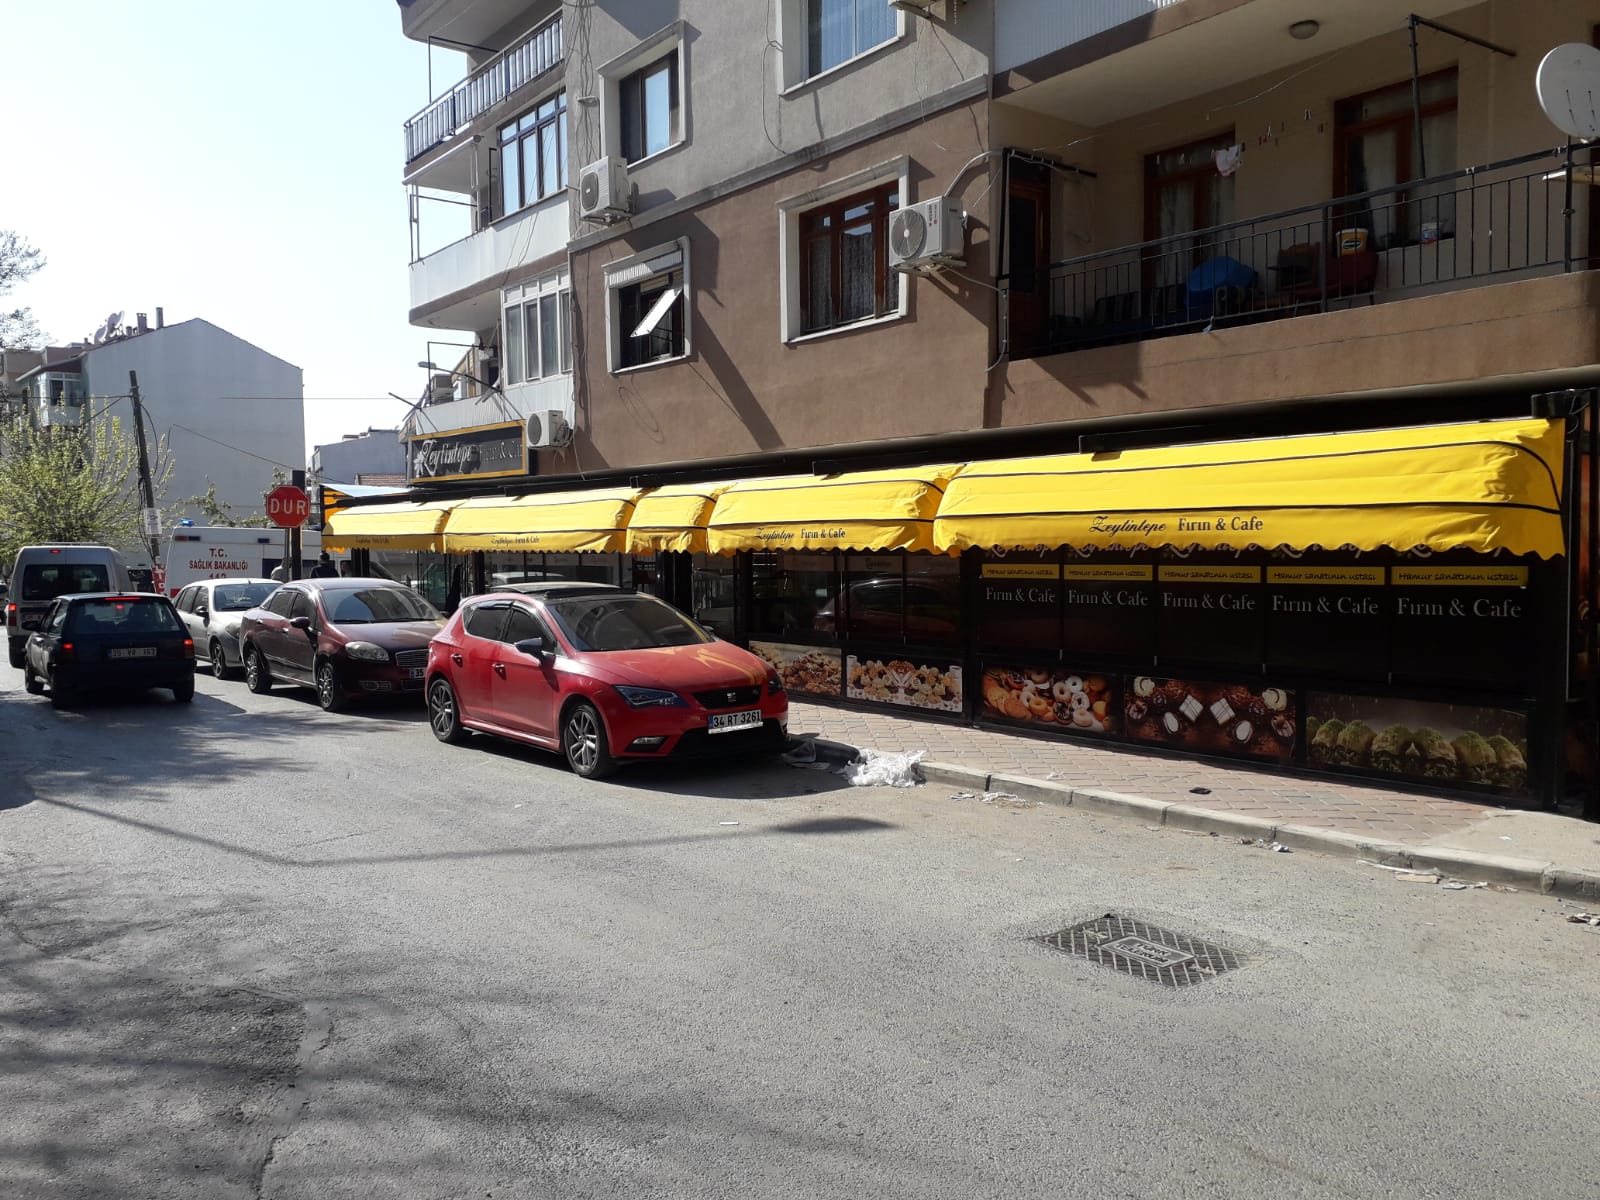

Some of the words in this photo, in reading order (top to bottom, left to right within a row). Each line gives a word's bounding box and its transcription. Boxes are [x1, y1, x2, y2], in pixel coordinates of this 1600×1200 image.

[270, 498, 306, 515] DUR
[1178, 517, 1211, 531] Fırın
[1215, 518, 1227, 531] &
[1231, 516, 1264, 531] Cafe
[820, 528, 827, 539] &
[828, 527, 846, 538] Cafe
[208, 548, 228, 558] T.C.
[985, 587, 1012, 601] Fırın
[1015, 588, 1025, 602] &
[1028, 587, 1056, 603] Cafe
[1068, 589, 1098, 604] Fırın
[1101, 590, 1113, 605] &
[1117, 589, 1149, 606] Cafe
[1163, 592, 1198, 608] Fırın
[1201, 593, 1214, 609] &
[1219, 593, 1256, 610] Cafe
[1272, 595, 1312, 612] Fırın
[1317, 596, 1331, 613] &
[1337, 596, 1379, 615] Cafe
[1397, 598, 1443, 616] Fırın
[1449, 598, 1466, 617] &
[1473, 598, 1522, 618] Cafe
[713, 716, 725, 728] 34
[728, 714, 738, 726] RT
[741, 711, 761, 723] 3261
